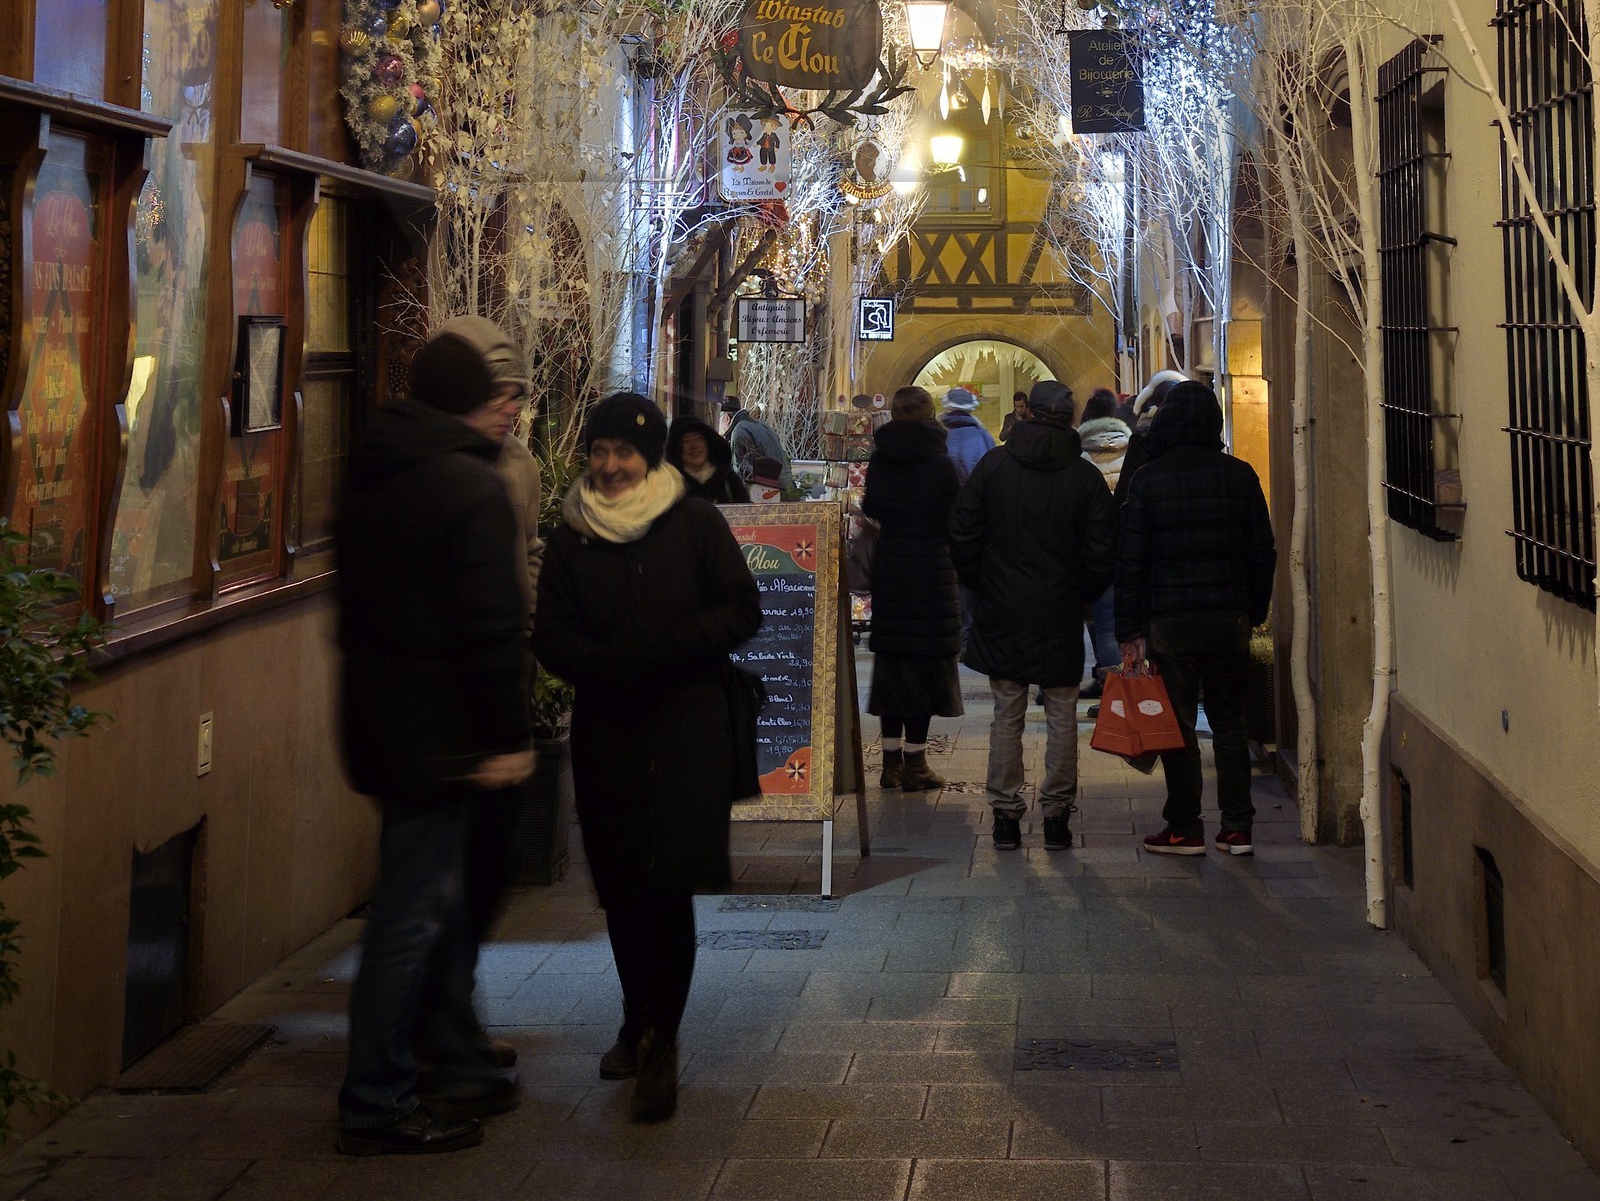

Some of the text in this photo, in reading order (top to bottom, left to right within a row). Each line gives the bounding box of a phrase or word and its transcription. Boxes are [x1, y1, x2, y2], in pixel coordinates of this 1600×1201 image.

[756, 0, 845, 28] Winstub
[752, 22, 840, 75] Le Clou
[1088, 40, 1124, 51] Atelier
[1099, 54, 1114, 66] de
[1079, 69, 1135, 83] Bijouterie
[731, 177, 741, 186] La
[743, 177, 765, 186] Maison
[752, 302, 791, 313] Antiquités
[741, 314, 802, 325] Bijoux Anciens
[740, 544, 780, 575] Clou
